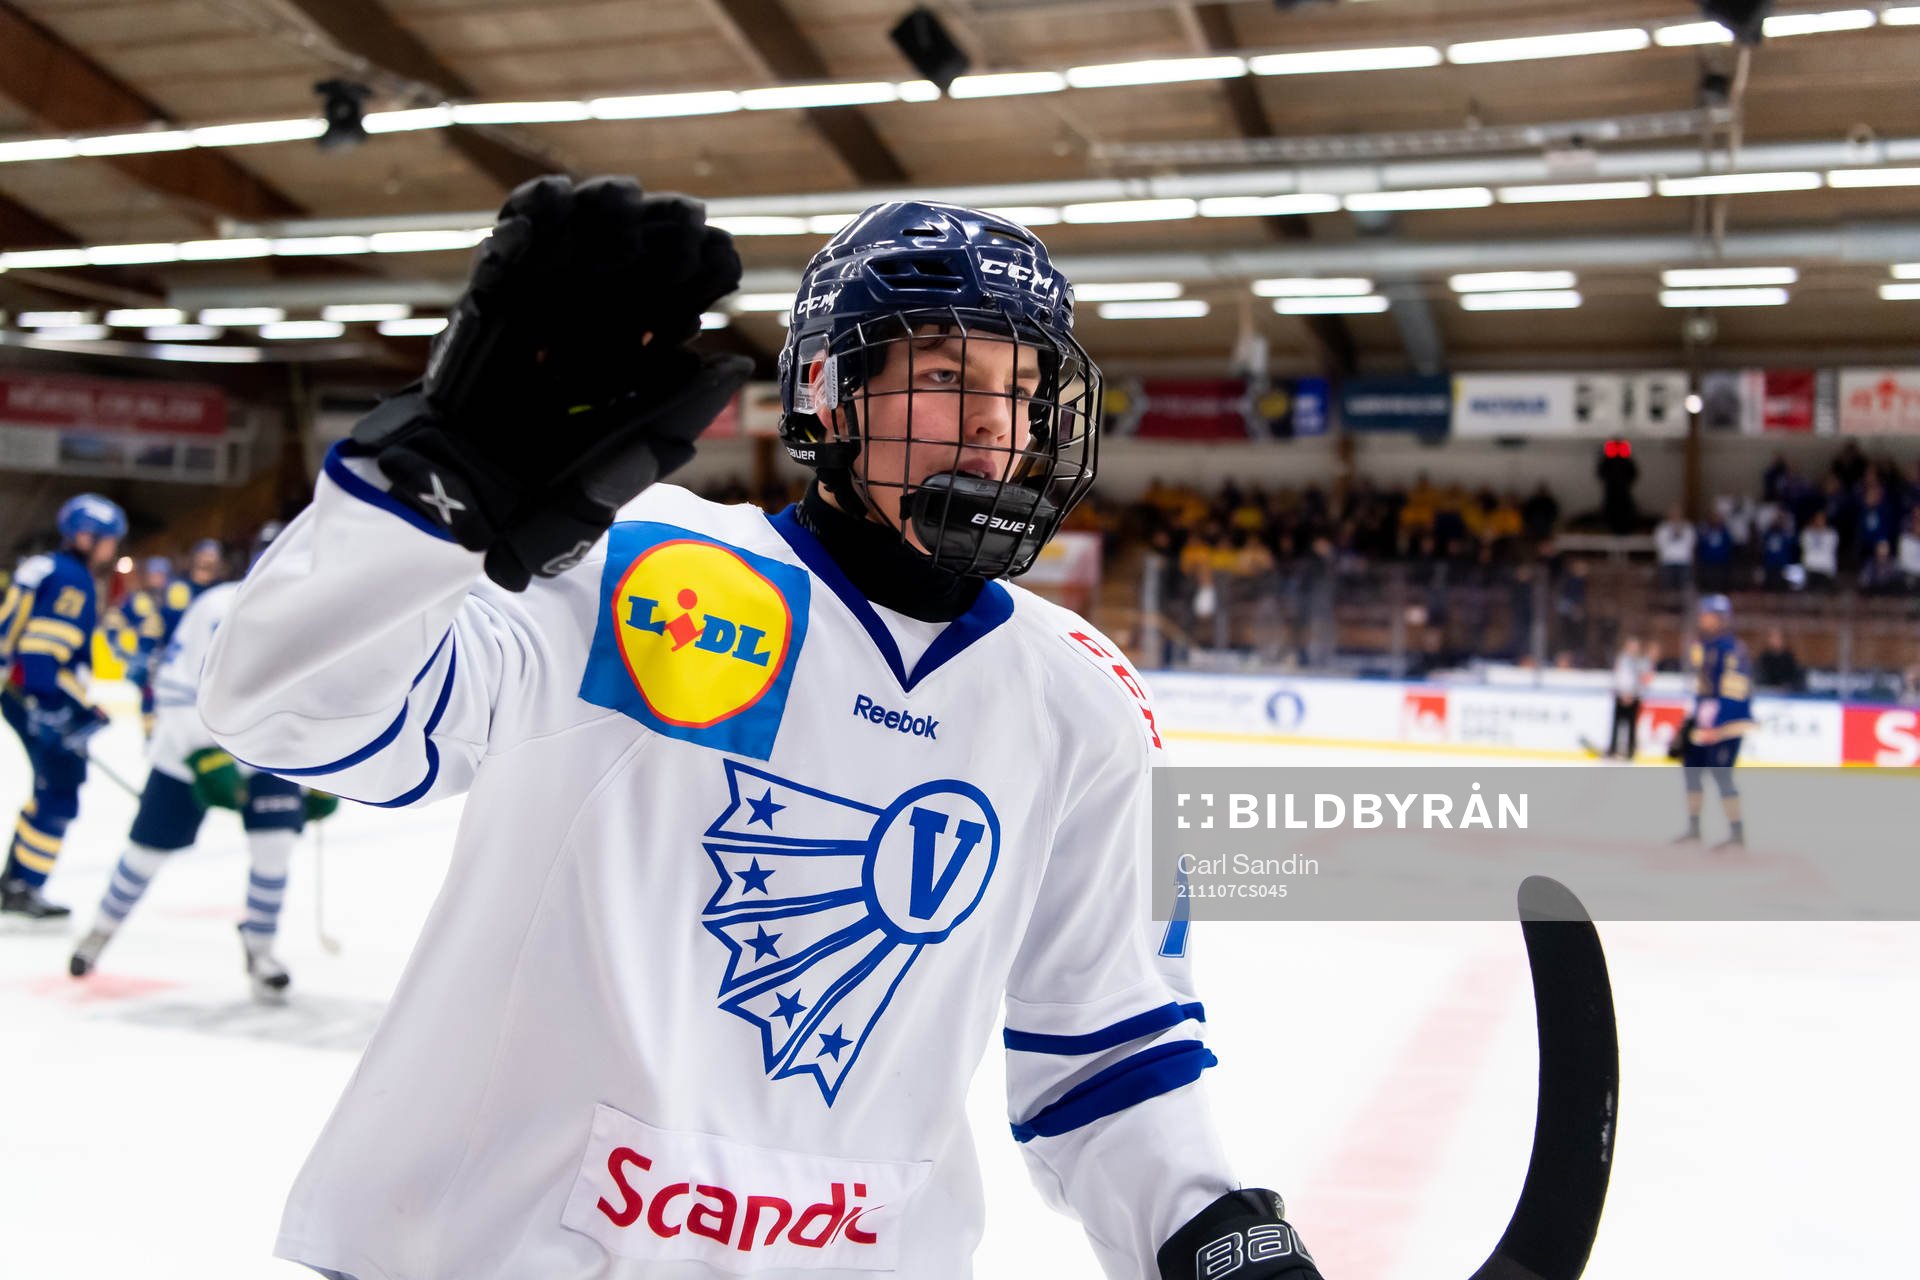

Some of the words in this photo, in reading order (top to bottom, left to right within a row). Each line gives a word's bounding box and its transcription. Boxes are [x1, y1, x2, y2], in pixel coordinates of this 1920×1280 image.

[980, 258, 1053, 291] CCM
[797, 290, 838, 315] CCM
[853, 694, 939, 740] Reebok
[909, 806, 986, 921] V
[596, 1146, 884, 1252] Scandic
